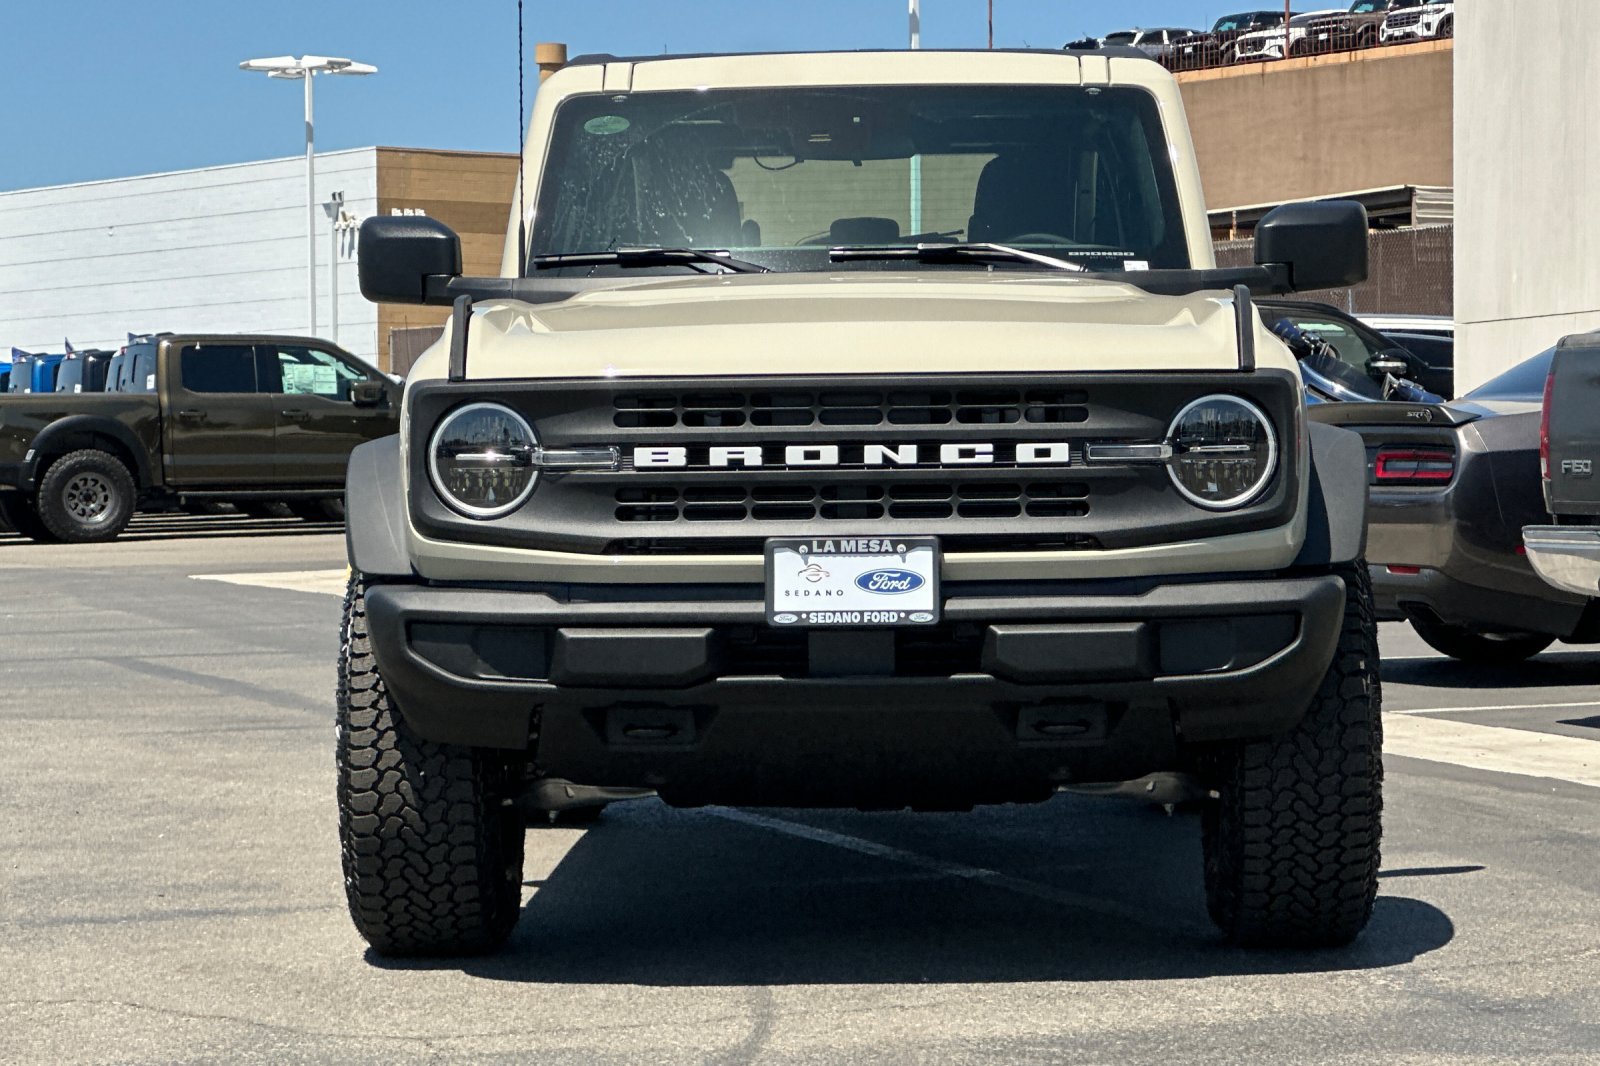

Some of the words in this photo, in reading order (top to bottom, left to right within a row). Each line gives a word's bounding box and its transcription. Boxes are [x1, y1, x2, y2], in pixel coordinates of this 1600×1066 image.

[633, 442, 1070, 467] BRONCO
[1561, 459, 1592, 474] F150
[812, 540, 836, 553] LA
[840, 539, 893, 553] MESA
[868, 570, 911, 590] Ford
[784, 589, 844, 597] SEDANO
[808, 611, 861, 624] SEDANO
[863, 611, 899, 623] FORD
